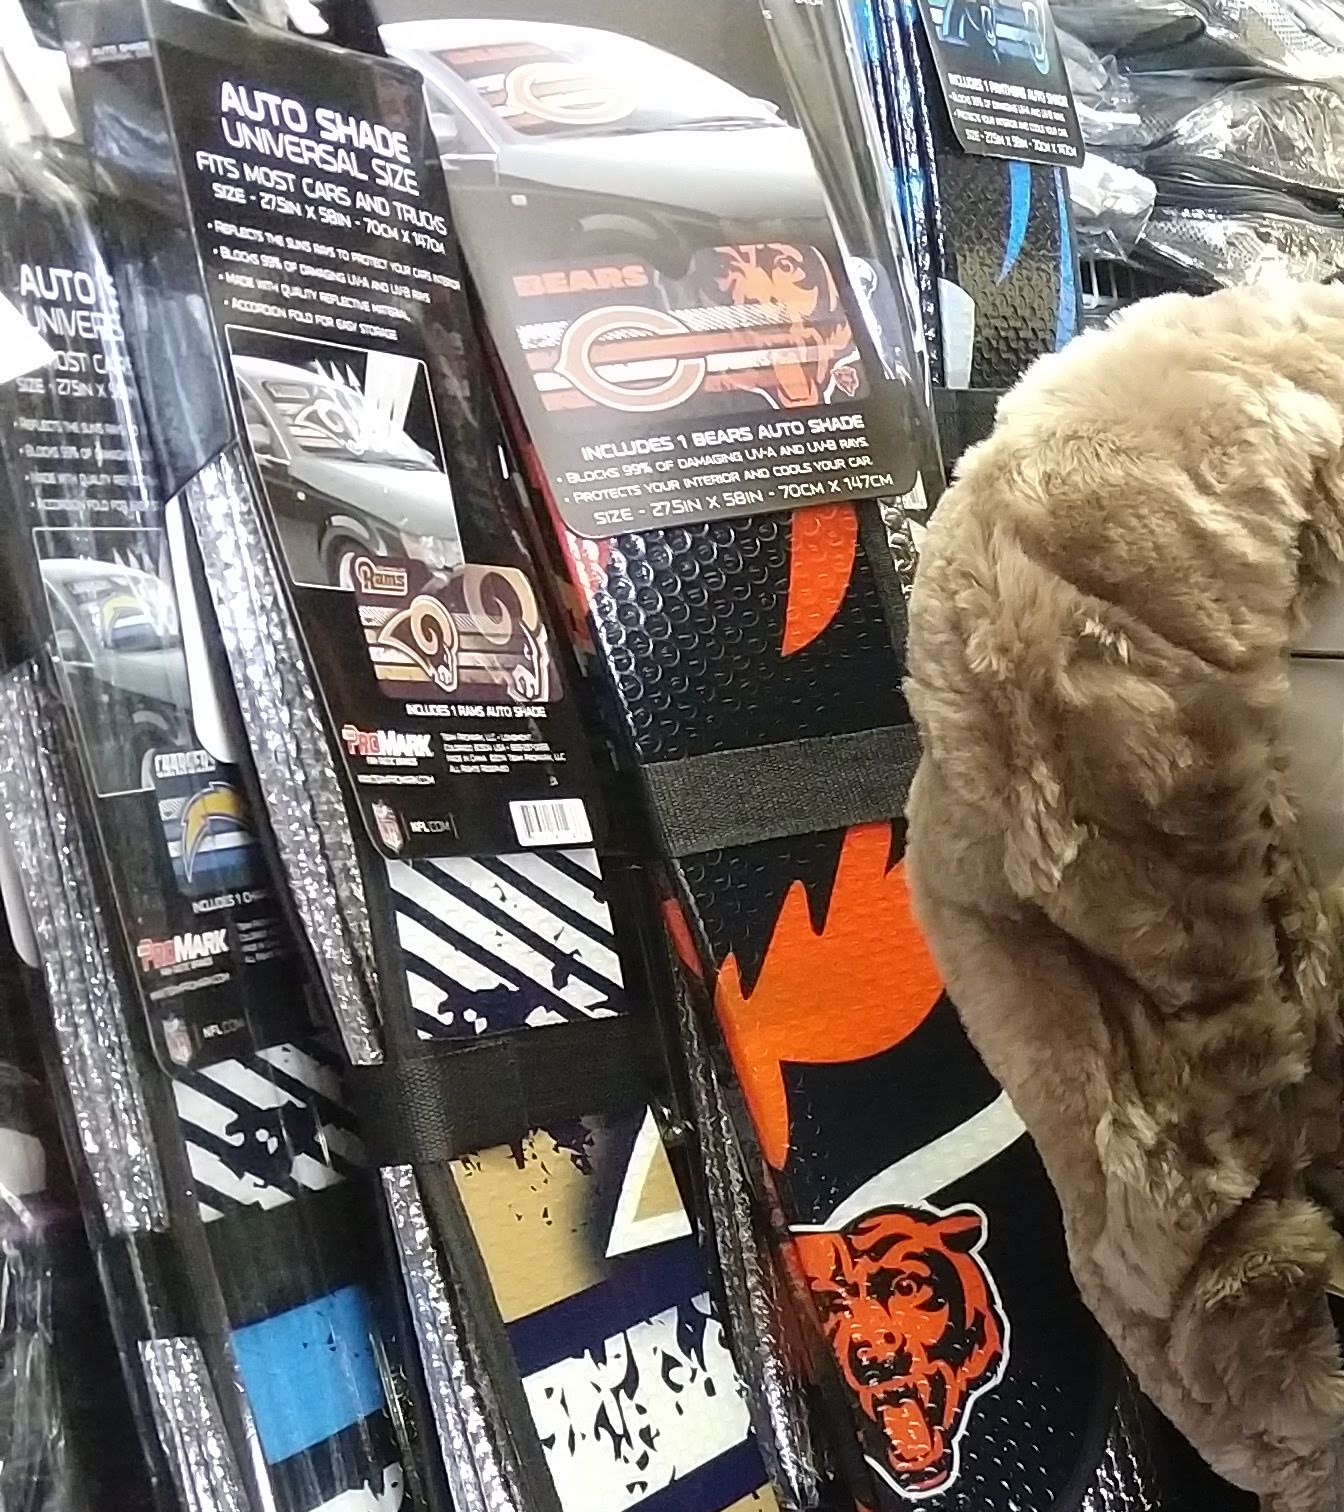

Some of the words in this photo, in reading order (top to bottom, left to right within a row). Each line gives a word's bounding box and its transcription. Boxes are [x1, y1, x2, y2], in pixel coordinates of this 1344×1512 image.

[221, 81, 308, 133] AUTO
[315, 107, 412, 164] SHADE
[221, 117, 368, 181] UNIVERSAL
[372, 157, 420, 196] SIZE
[196, 151, 240, 179] FITS
[243, 162, 296, 192] MOST
[302, 178, 351, 206] CARS
[356, 191, 389, 217] AND
[392, 201, 448, 236] TRUCKS
[212, 183, 247, 204] SIZE
[304, 204, 317, 220] X
[318, 206, 352, 229] 58IN
[401, 229, 412, 244] X
[20, 263, 96, 304] AUTO
[513, 264, 649, 297] BEARS
[566, 467, 620, 484] BLOCKS
[622, 462, 653, 477] 99%
[655, 459, 675, 473] OF
[677, 450, 744, 470] DAMAGING
[744, 446, 778, 461] UV-A
[779, 444, 805, 456] AND
[806, 439, 838, 453] UV-B
[581, 436, 675, 461] INCLUDES
[676, 434, 689, 450] 1
[691, 426, 754, 448] BEARS
[758, 421, 805, 440] AUTO
[808, 414, 866, 435] SHADE
[572, 484, 642, 504] PROTECTS
[643, 479, 681, 494] YOUR
[683, 471, 741, 489] INTERIOR
[743, 467, 770, 481] AND
[772, 462, 813, 478] COOLS
[812, 458, 847, 472] YOUR
[593, 507, 635, 526] SIZE
[706, 495, 721, 510] X
[722, 489, 764, 507] 58IN
[777, 482, 826, 499] 70CM
[827, 479, 841, 493] X
[843, 473, 894, 491] 147CM
